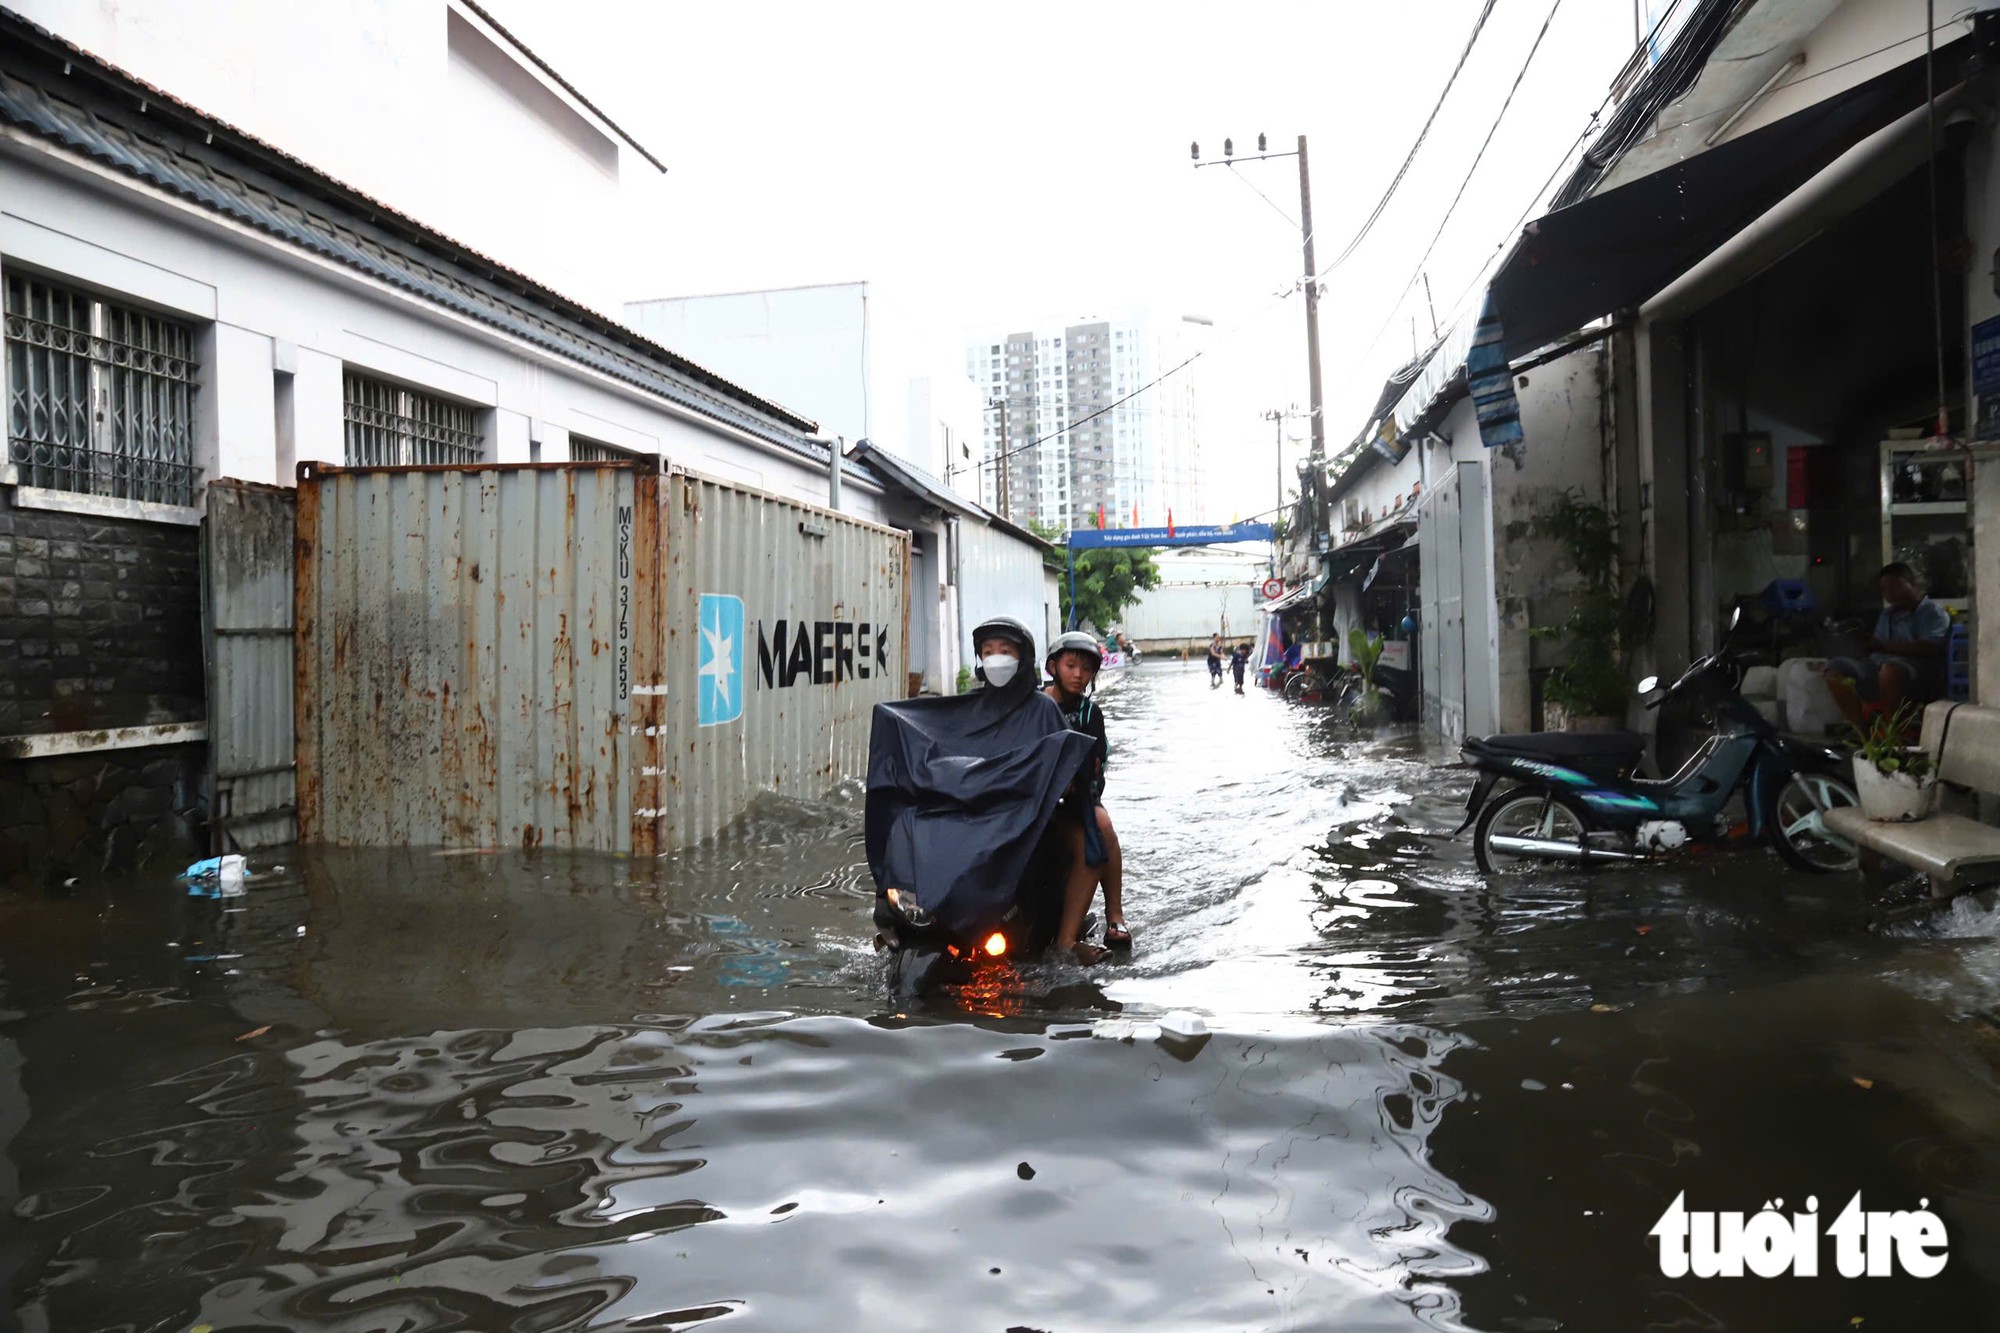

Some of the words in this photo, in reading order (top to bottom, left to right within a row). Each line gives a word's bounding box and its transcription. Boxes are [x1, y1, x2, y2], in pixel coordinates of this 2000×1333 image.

[618, 506, 632, 579] MSKU
[619, 585, 628, 640] 375
[619, 645, 628, 700] 353
[757, 619, 889, 691] MAERSK
